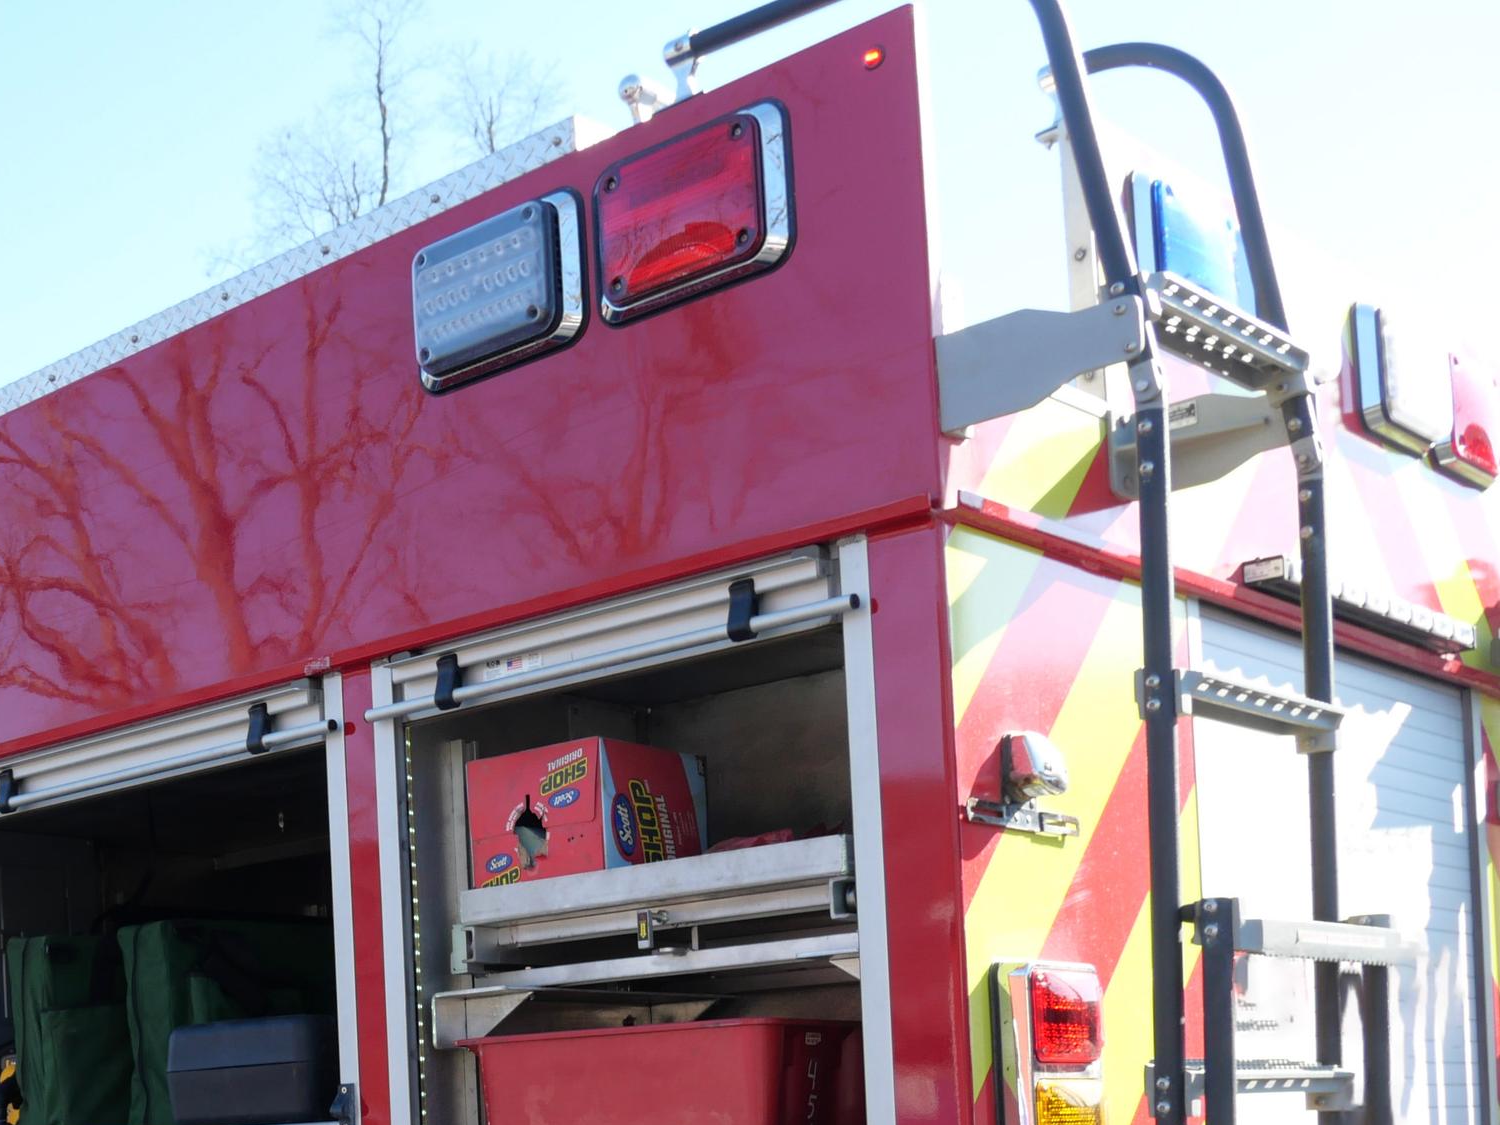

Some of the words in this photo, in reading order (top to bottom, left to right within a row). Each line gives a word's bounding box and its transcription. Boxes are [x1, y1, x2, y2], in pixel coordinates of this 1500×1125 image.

[548, 748, 583, 771] ORIGINAL
[540, 757, 587, 796] SHOP
[554, 790, 575, 806] Scott
[617, 803, 633, 846] Scott
[490, 855, 508, 871] Scott
[482, 867, 521, 889] HOP
